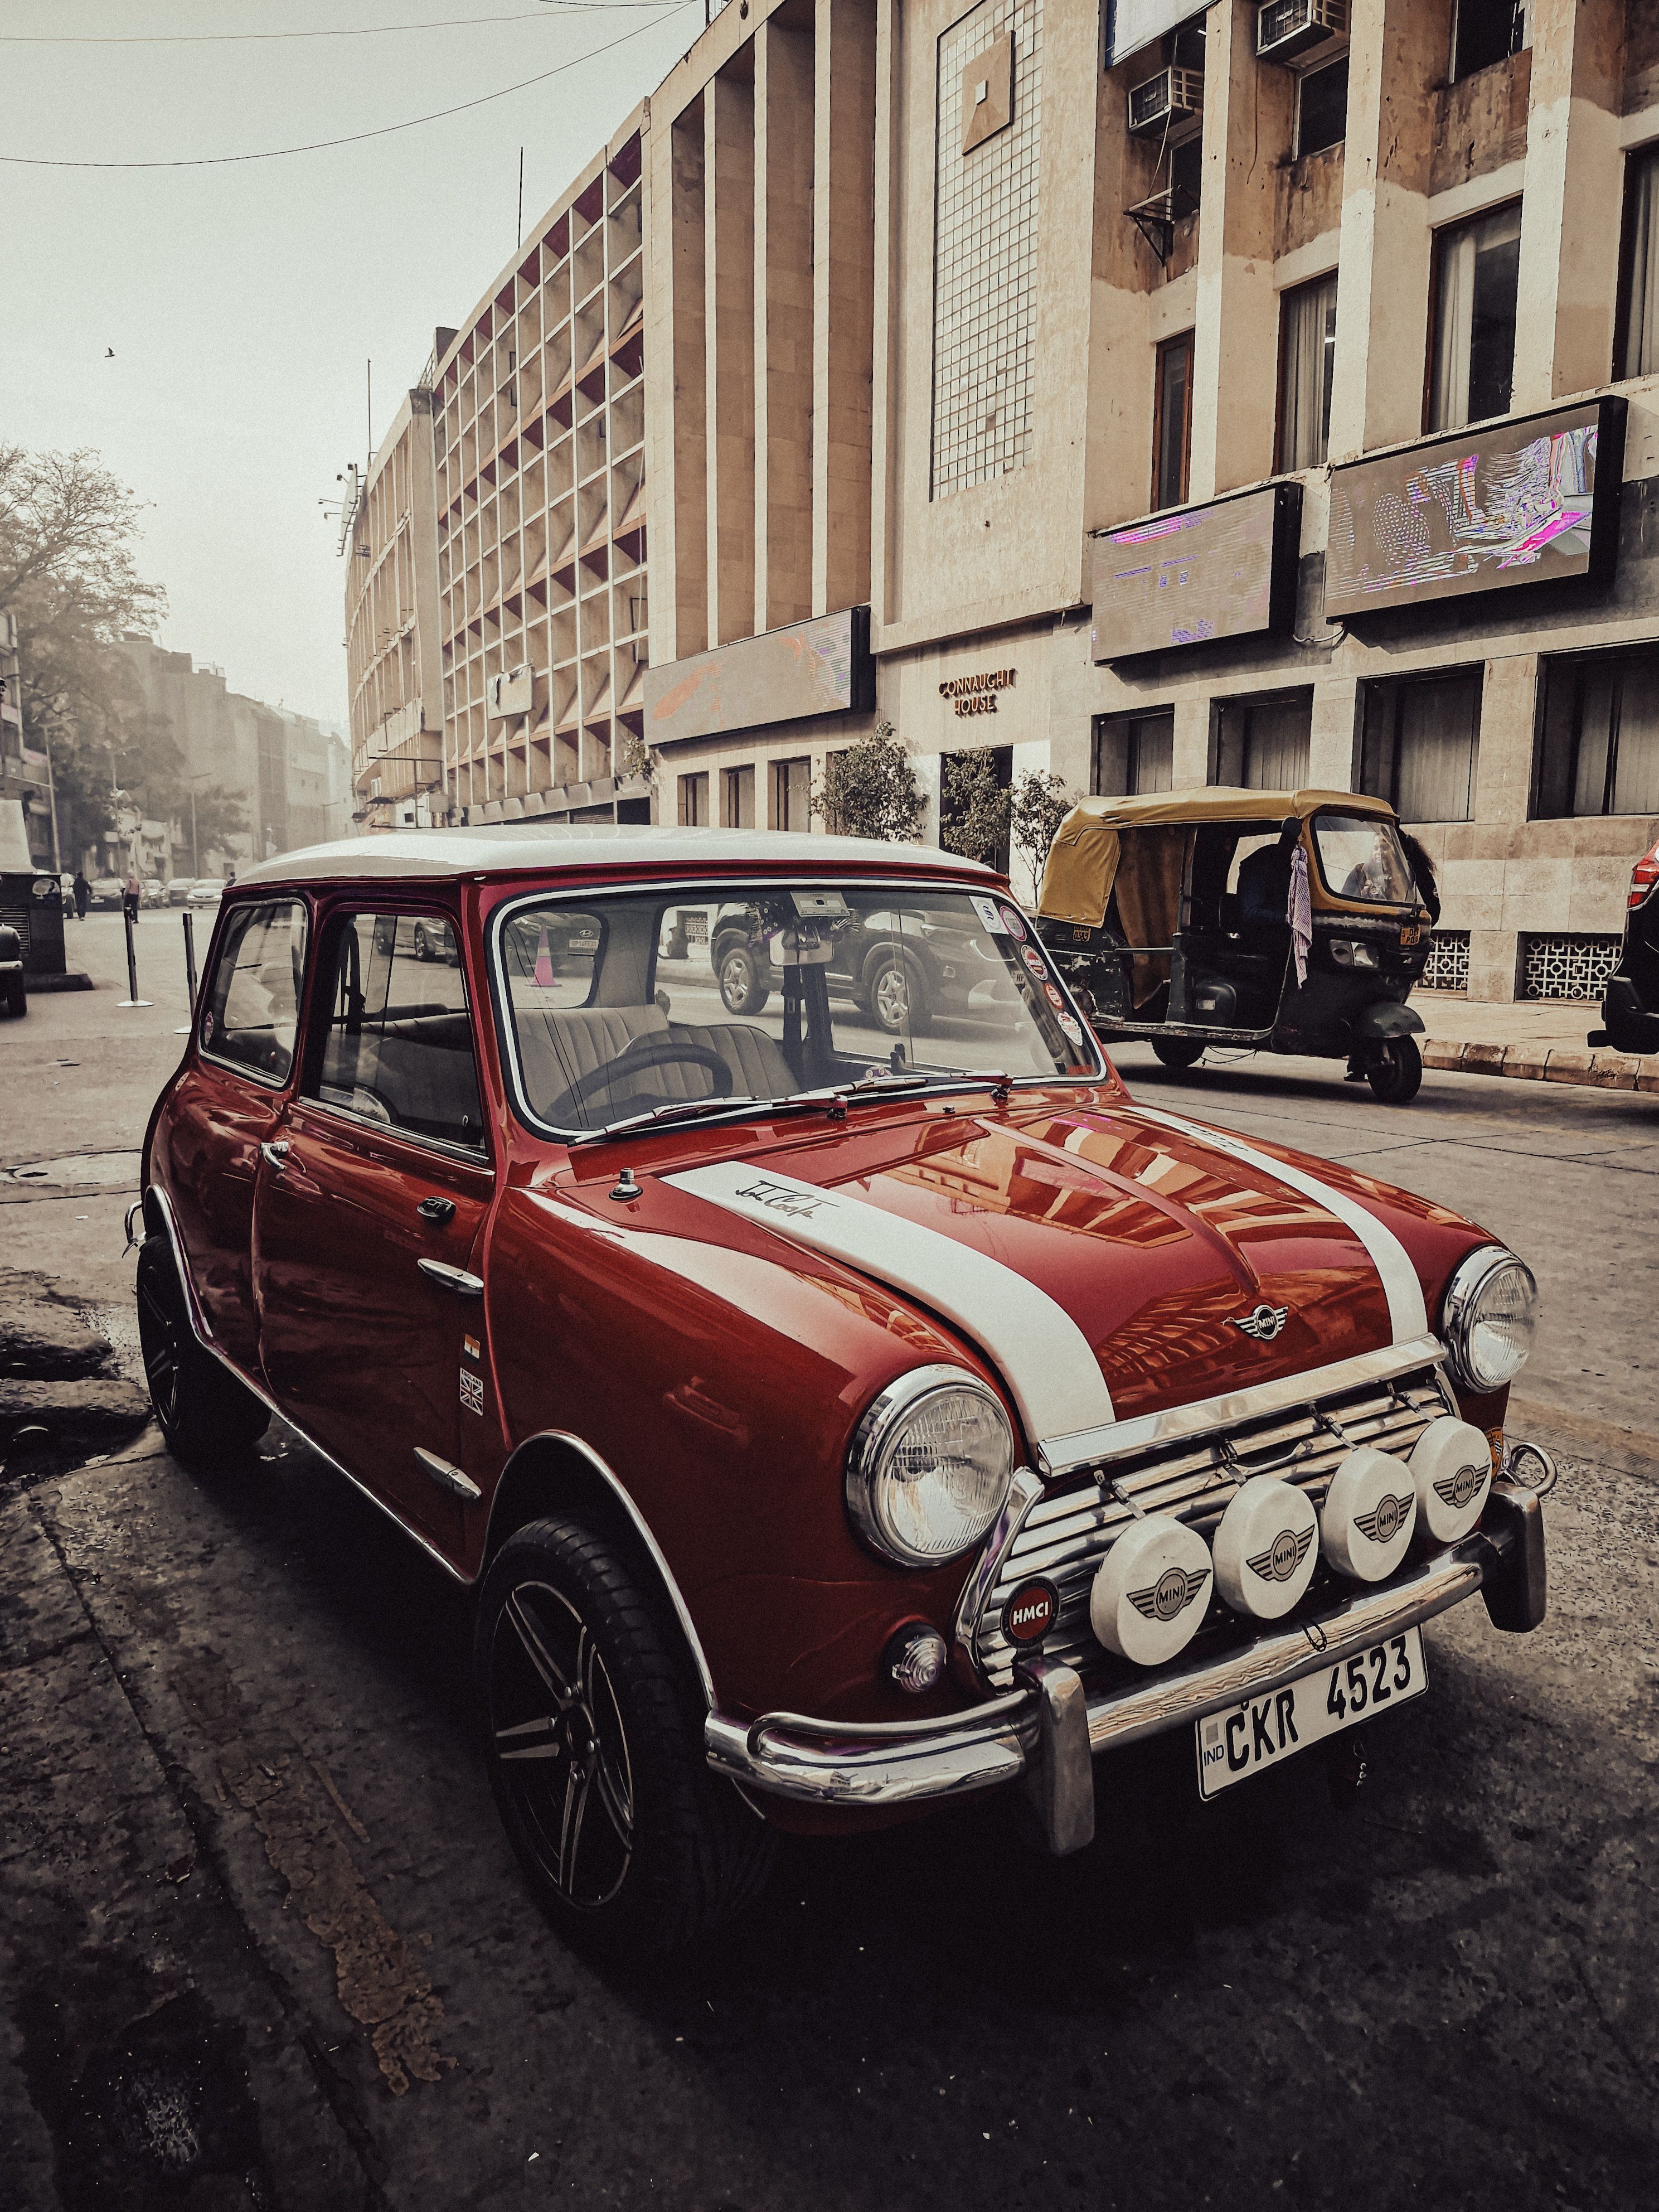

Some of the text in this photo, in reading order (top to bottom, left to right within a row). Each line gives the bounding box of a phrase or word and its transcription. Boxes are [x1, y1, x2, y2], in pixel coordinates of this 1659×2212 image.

[939, 668, 1016, 697] CONNAUGHT
[955, 694, 997, 714] HOUSE
[1258, 1315, 1276, 1329] MINI
[462, 1369, 482, 1387] ENGLAND
[1456, 1478, 1473, 1493] MINI
[1379, 1509, 1396, 1527] MINI
[1274, 1545, 1296, 1566] MINI
[1158, 1585, 1183, 1604] MINI
[1013, 1601, 1049, 1625] HMCI
[1225, 1634, 1411, 1772] CKR 4523
[1204, 1744, 1224, 1766] IND
